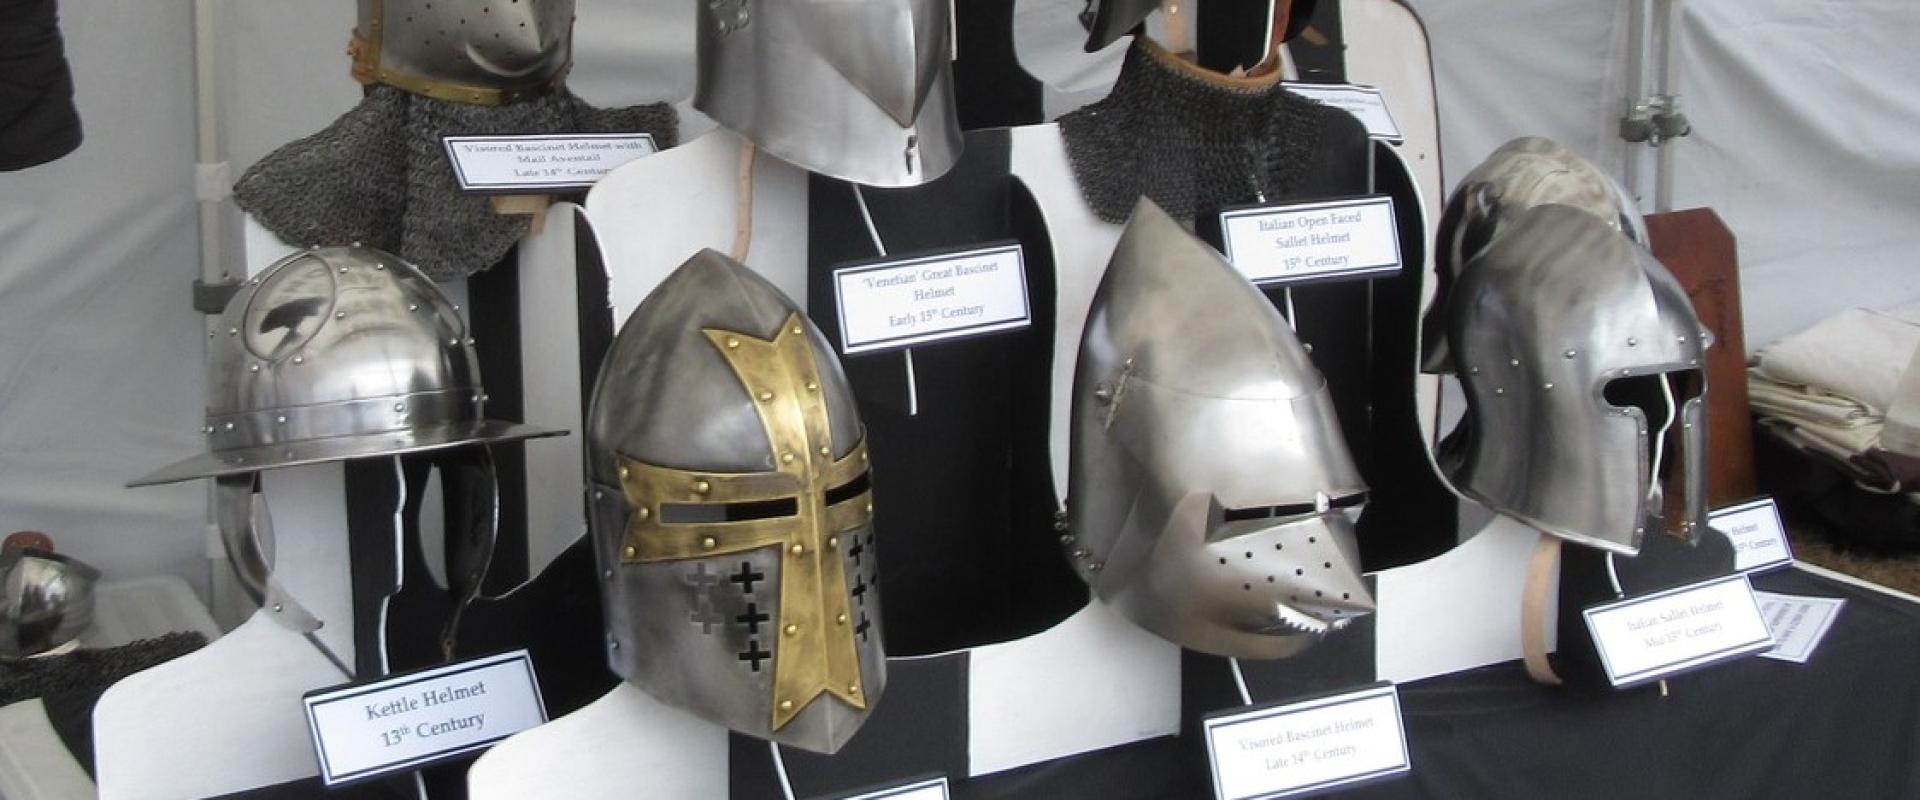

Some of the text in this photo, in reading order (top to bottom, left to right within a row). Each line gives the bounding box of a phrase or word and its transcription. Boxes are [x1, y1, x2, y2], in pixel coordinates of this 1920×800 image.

[463, 141, 643, 153] Visored Bascinet Helmet with
[517, 154, 601, 163] Mail Aventail
[514, 168, 540, 177] Late
[567, 167, 611, 177] Centur
[1258, 210, 1362, 232] Italian Open Faced
[1276, 231, 1351, 249] Sallet Helmet
[1305, 253, 1350, 268] Century
[922, 267, 954, 282] Great
[955, 261, 999, 277] Bascinet
[913, 286, 956, 302] Helmet
[888, 313, 917, 328] Early
[941, 302, 986, 319] Century
[1685, 621, 1723, 639] Century
[364, 680, 488, 721] Kettle Helmet
[380, 712, 486, 748] 13th Century
[1238, 716, 1375, 751] Visored Bascinet Helmet
[1264, 757, 1289, 772] Late
[1313, 743, 1358, 762] Century
